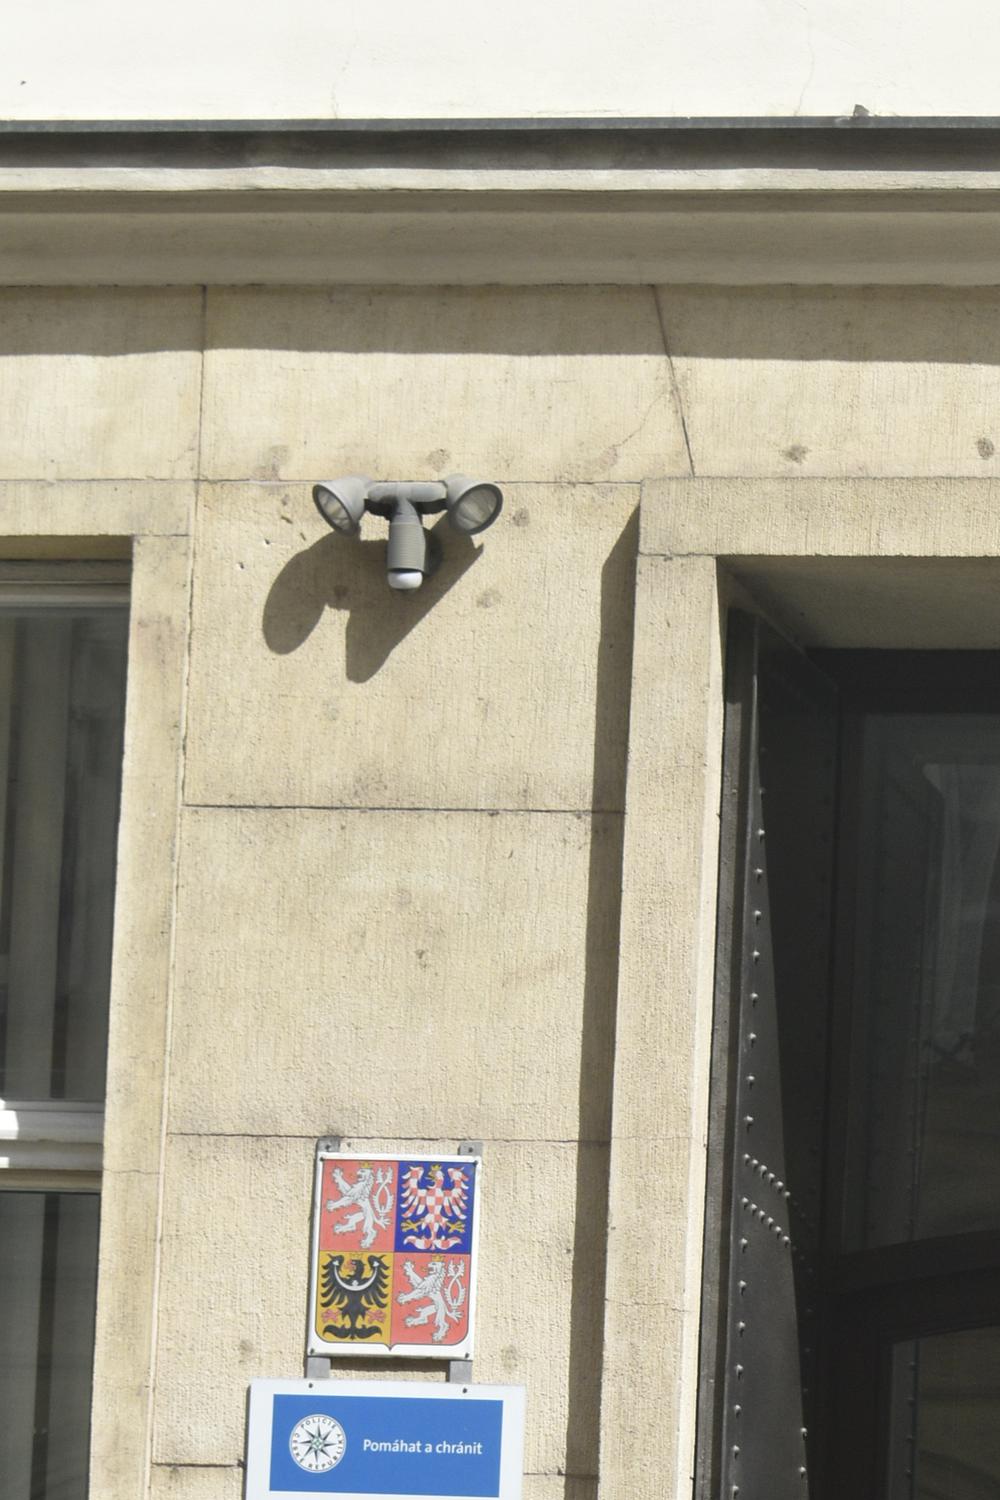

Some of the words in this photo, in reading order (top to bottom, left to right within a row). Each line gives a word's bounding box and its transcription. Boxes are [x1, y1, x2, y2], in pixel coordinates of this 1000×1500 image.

[301, 1417, 337, 1429] POLICIE
[363, 1439, 422, 1453] Pomáhat
[424, 1443, 433, 1453] a
[435, 1440, 483, 1455] chránit
